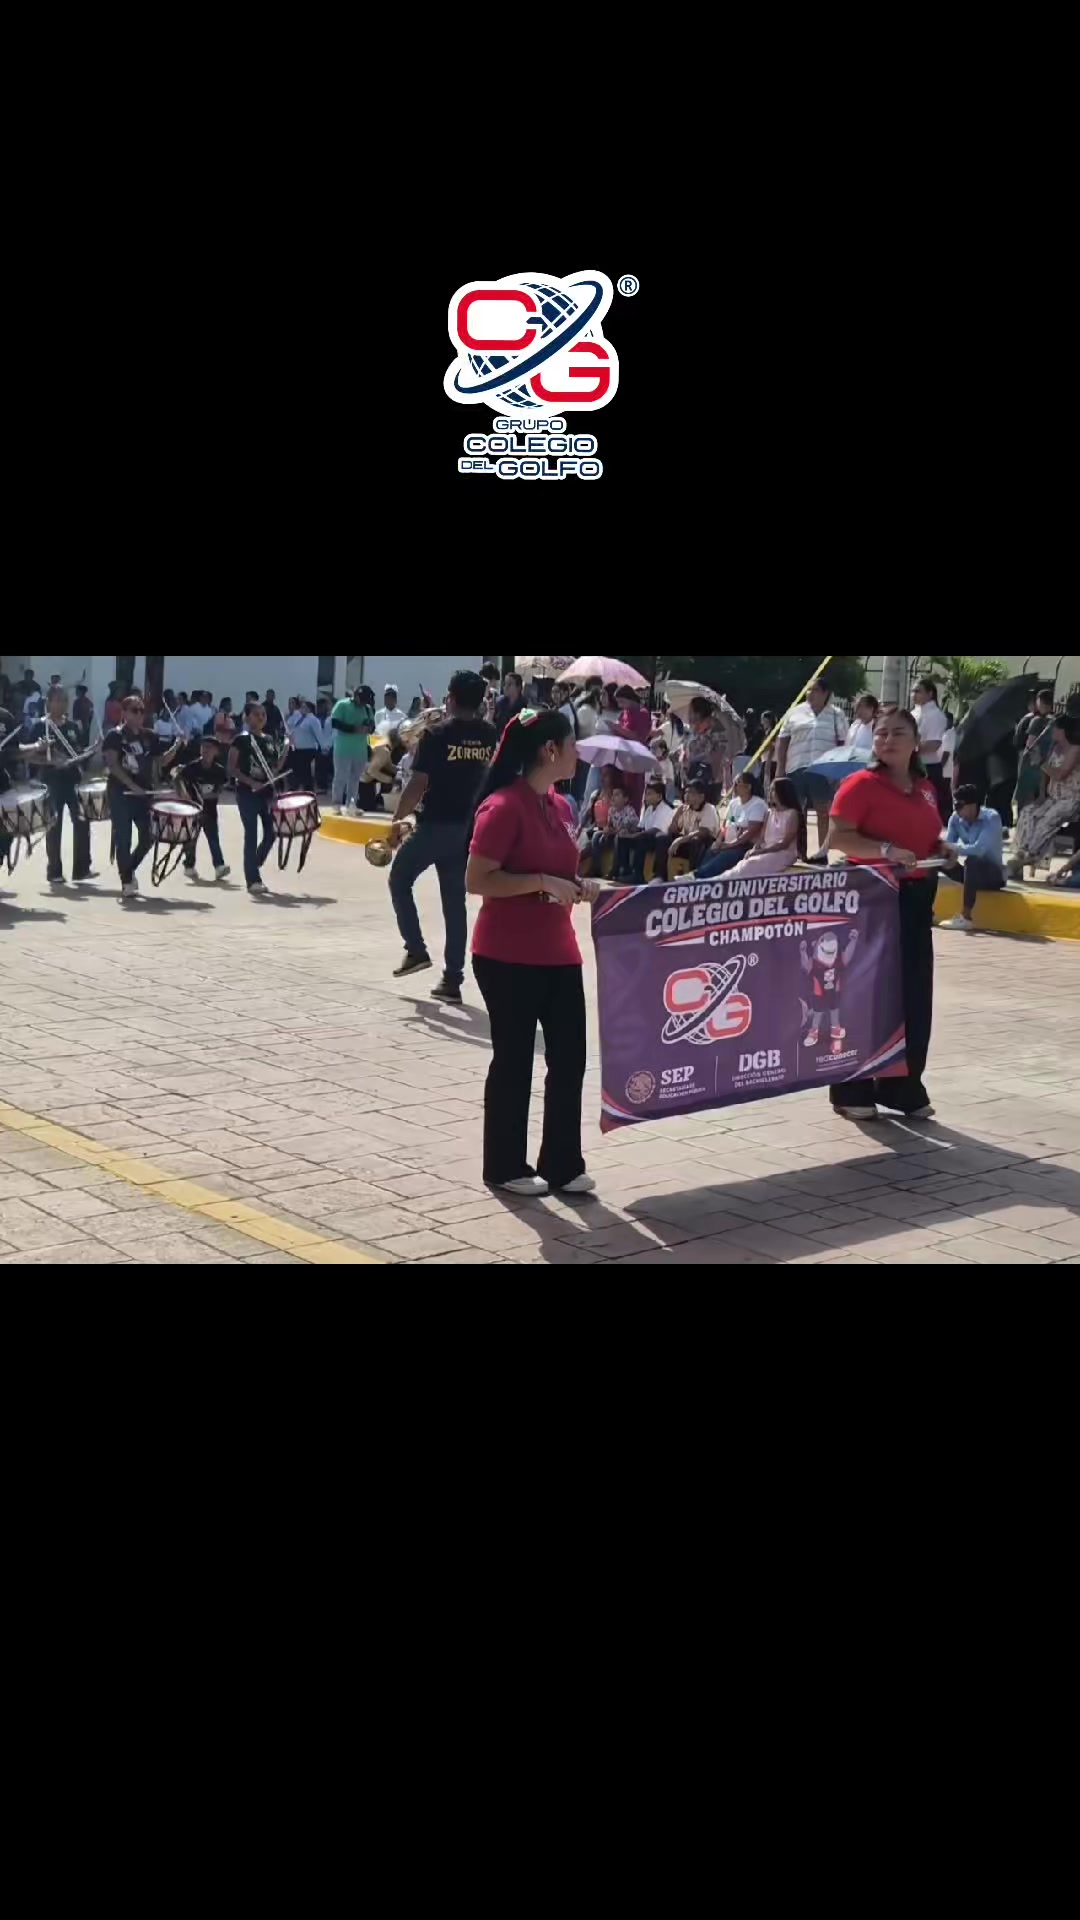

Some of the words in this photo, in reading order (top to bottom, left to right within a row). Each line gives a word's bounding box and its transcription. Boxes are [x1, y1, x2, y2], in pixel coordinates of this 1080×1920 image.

[447, 745, 491, 761] ZORROS
[663, 884, 723, 903] GRUPO
[728, 872, 848, 897] UNIVERSITARIO
[645, 898, 744, 937] COLEGIO
[748, 897, 789, 917] DEL
[794, 890, 860, 914] GOLFO
[709, 920, 804, 946] CHAMPOTÓN
[739, 1050, 780, 1072] DGB
[661, 1066, 694, 1085] SEP
